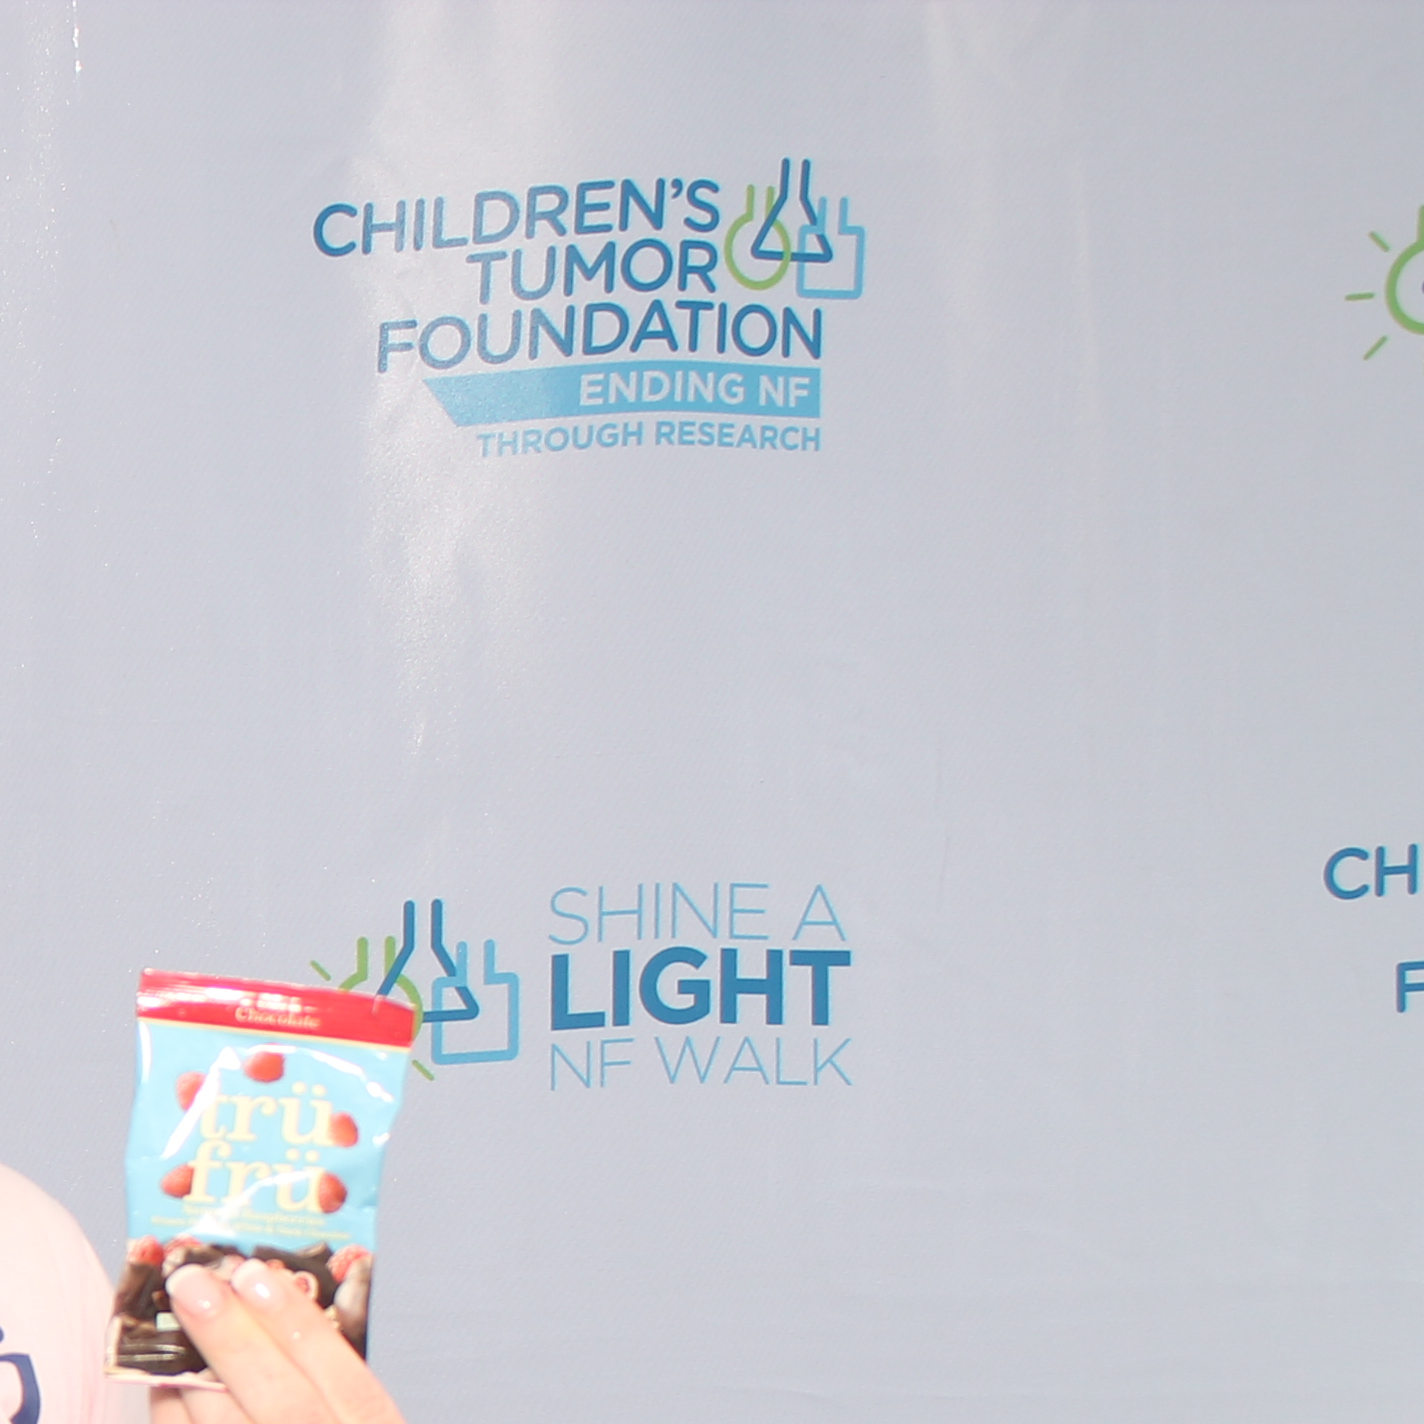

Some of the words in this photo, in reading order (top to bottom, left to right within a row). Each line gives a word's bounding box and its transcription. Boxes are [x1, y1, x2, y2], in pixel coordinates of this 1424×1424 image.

[313, 177, 721, 258] CHILDREN'S
[466, 238, 717, 305] TUMOR
[377, 299, 821, 374] FOUNDATION
[578, 372, 744, 407] ENDING
[759, 376, 809, 408] NF
[477, 421, 644, 458] THROUGH
[655, 421, 821, 452] RESEARCH
[549, 882, 769, 945] SHINE
[793, 884, 845, 941] A
[551, 946, 852, 1031] LIGHT
[550, 1037, 634, 1091] NF
[654, 1035, 853, 1086] WALK
